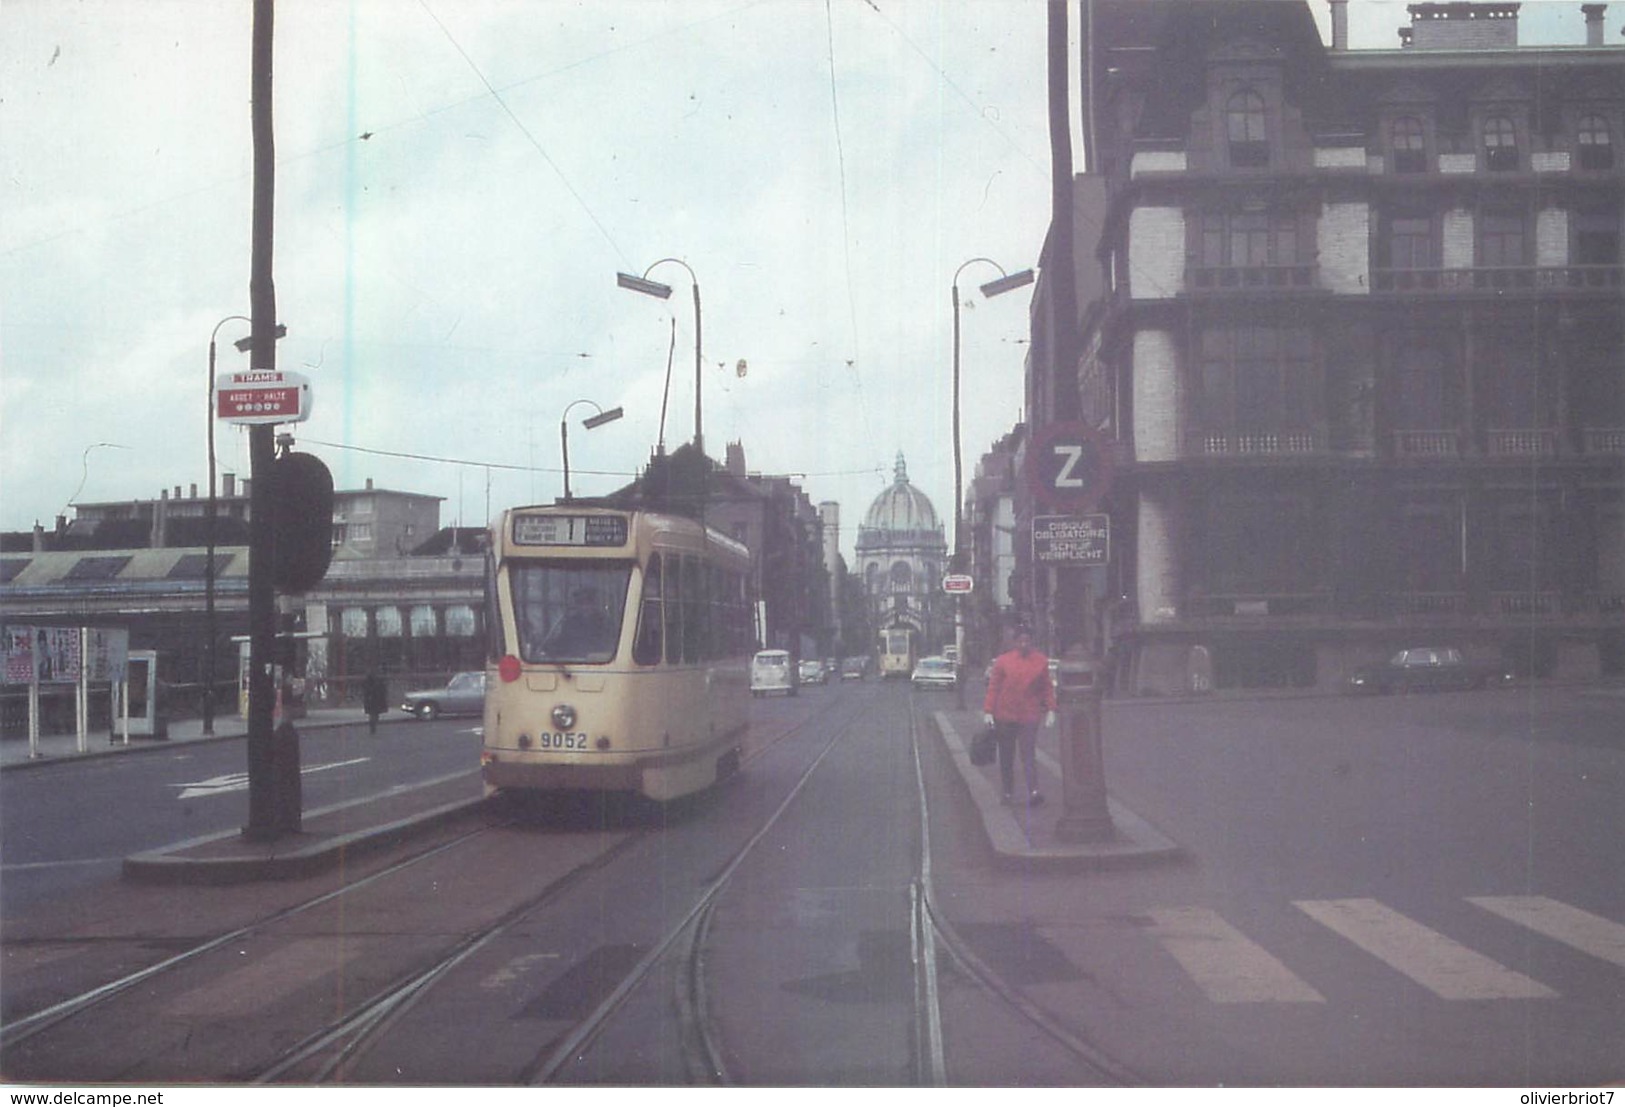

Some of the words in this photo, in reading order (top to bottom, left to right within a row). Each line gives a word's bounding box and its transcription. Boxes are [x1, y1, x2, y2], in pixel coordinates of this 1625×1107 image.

[1054, 445, 1084, 487] Z
[567, 518, 574, 540] 1
[1035, 529, 1105, 540] OBLIGATOIRE
[1039, 550, 1103, 561] VERPLICHT
[541, 732, 587, 749] 9052
